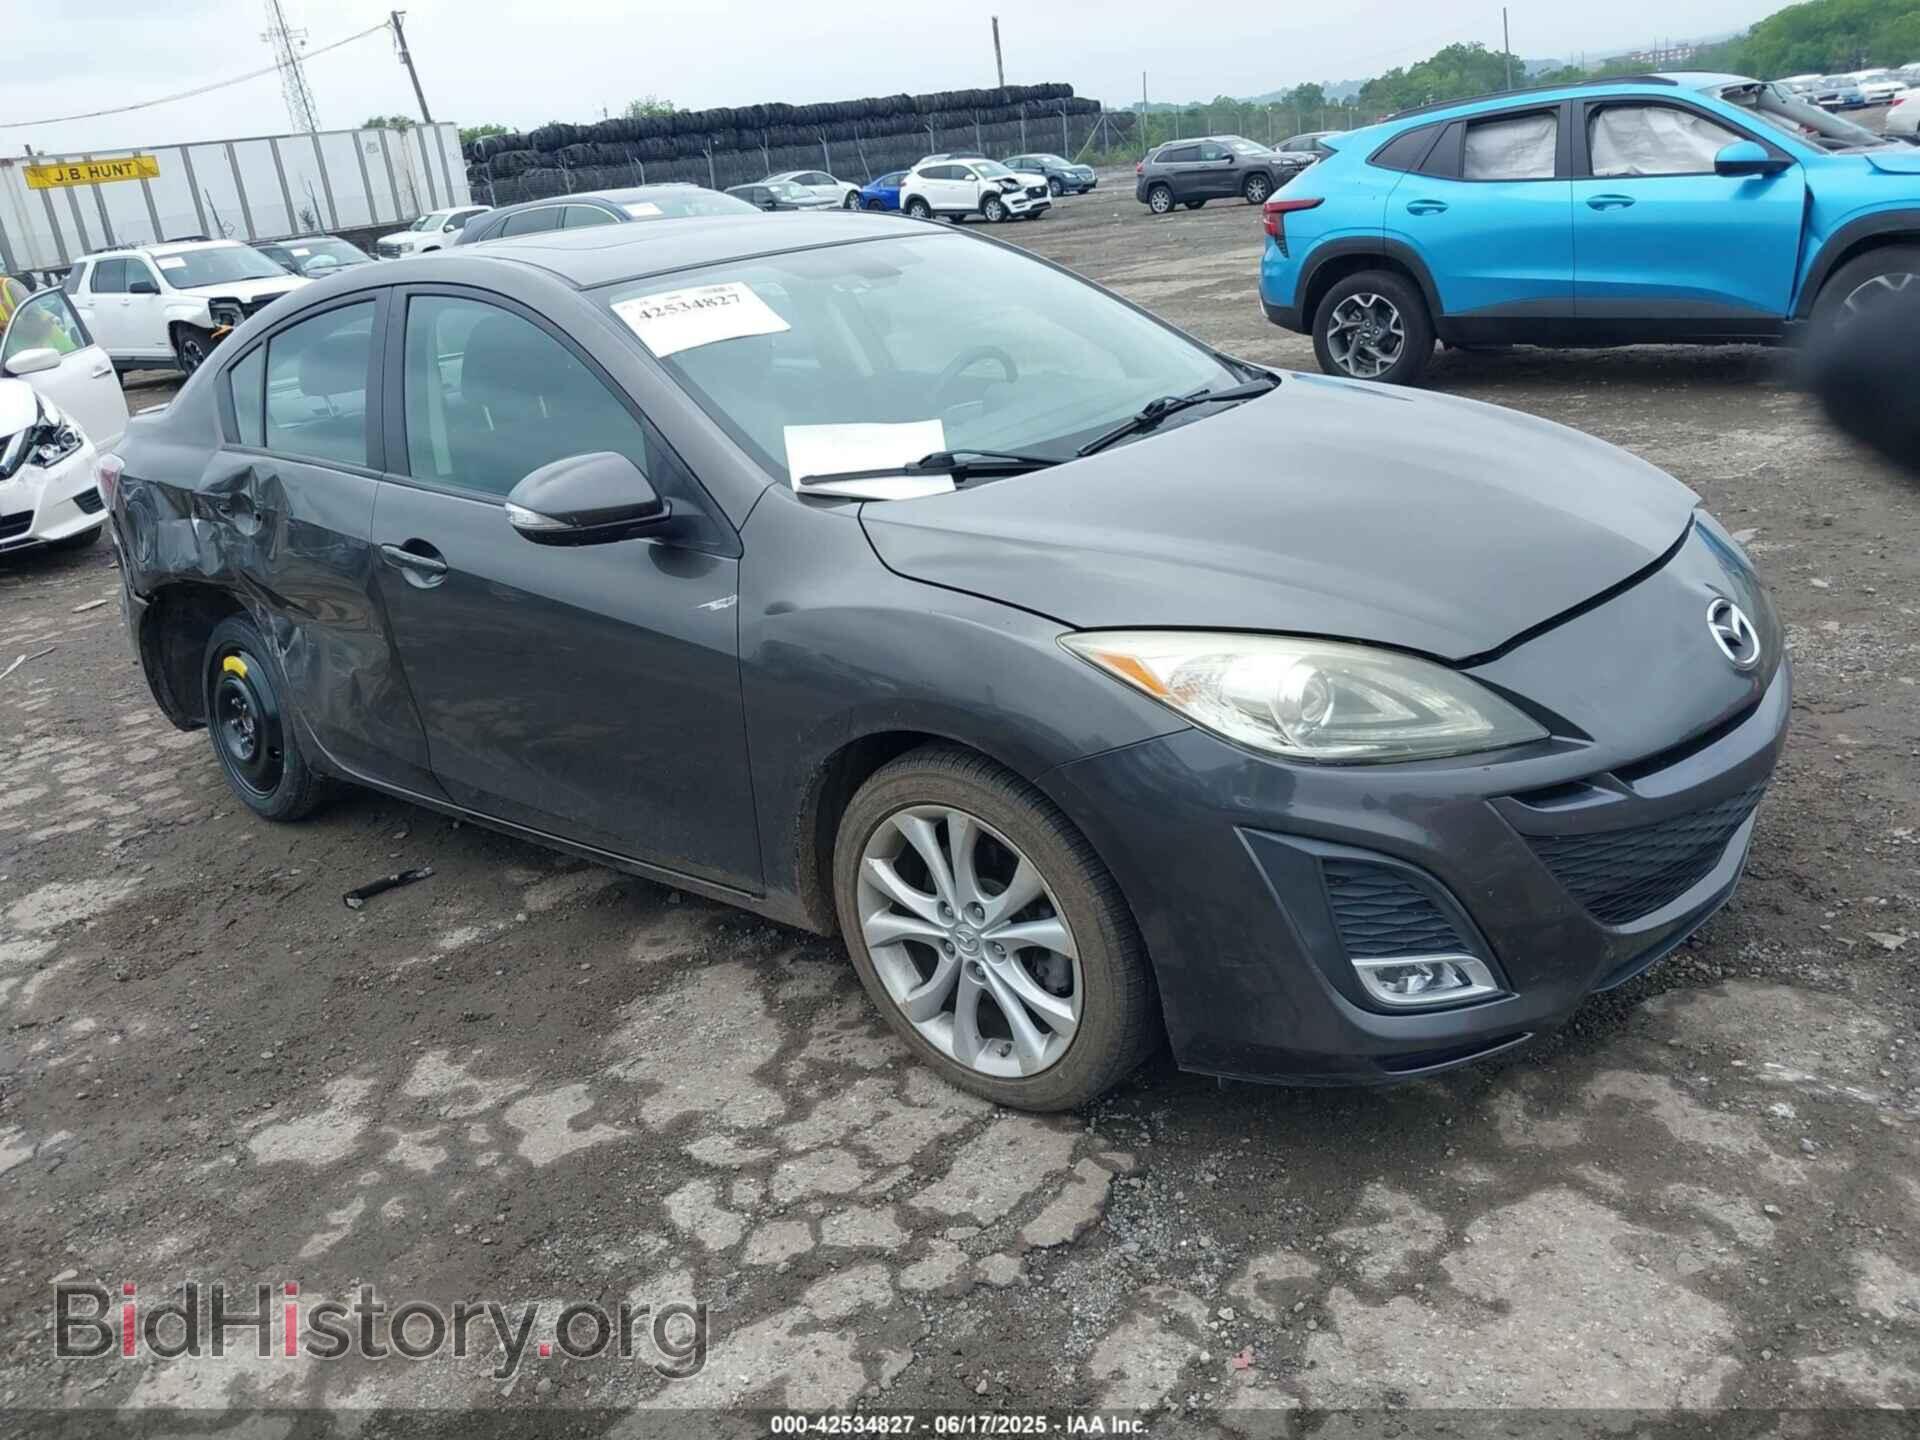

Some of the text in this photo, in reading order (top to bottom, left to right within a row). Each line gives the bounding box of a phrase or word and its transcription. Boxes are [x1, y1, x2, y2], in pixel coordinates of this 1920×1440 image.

[55, 162, 133, 183] J.B. HUNT
[639, 293, 741, 320] 42534827
